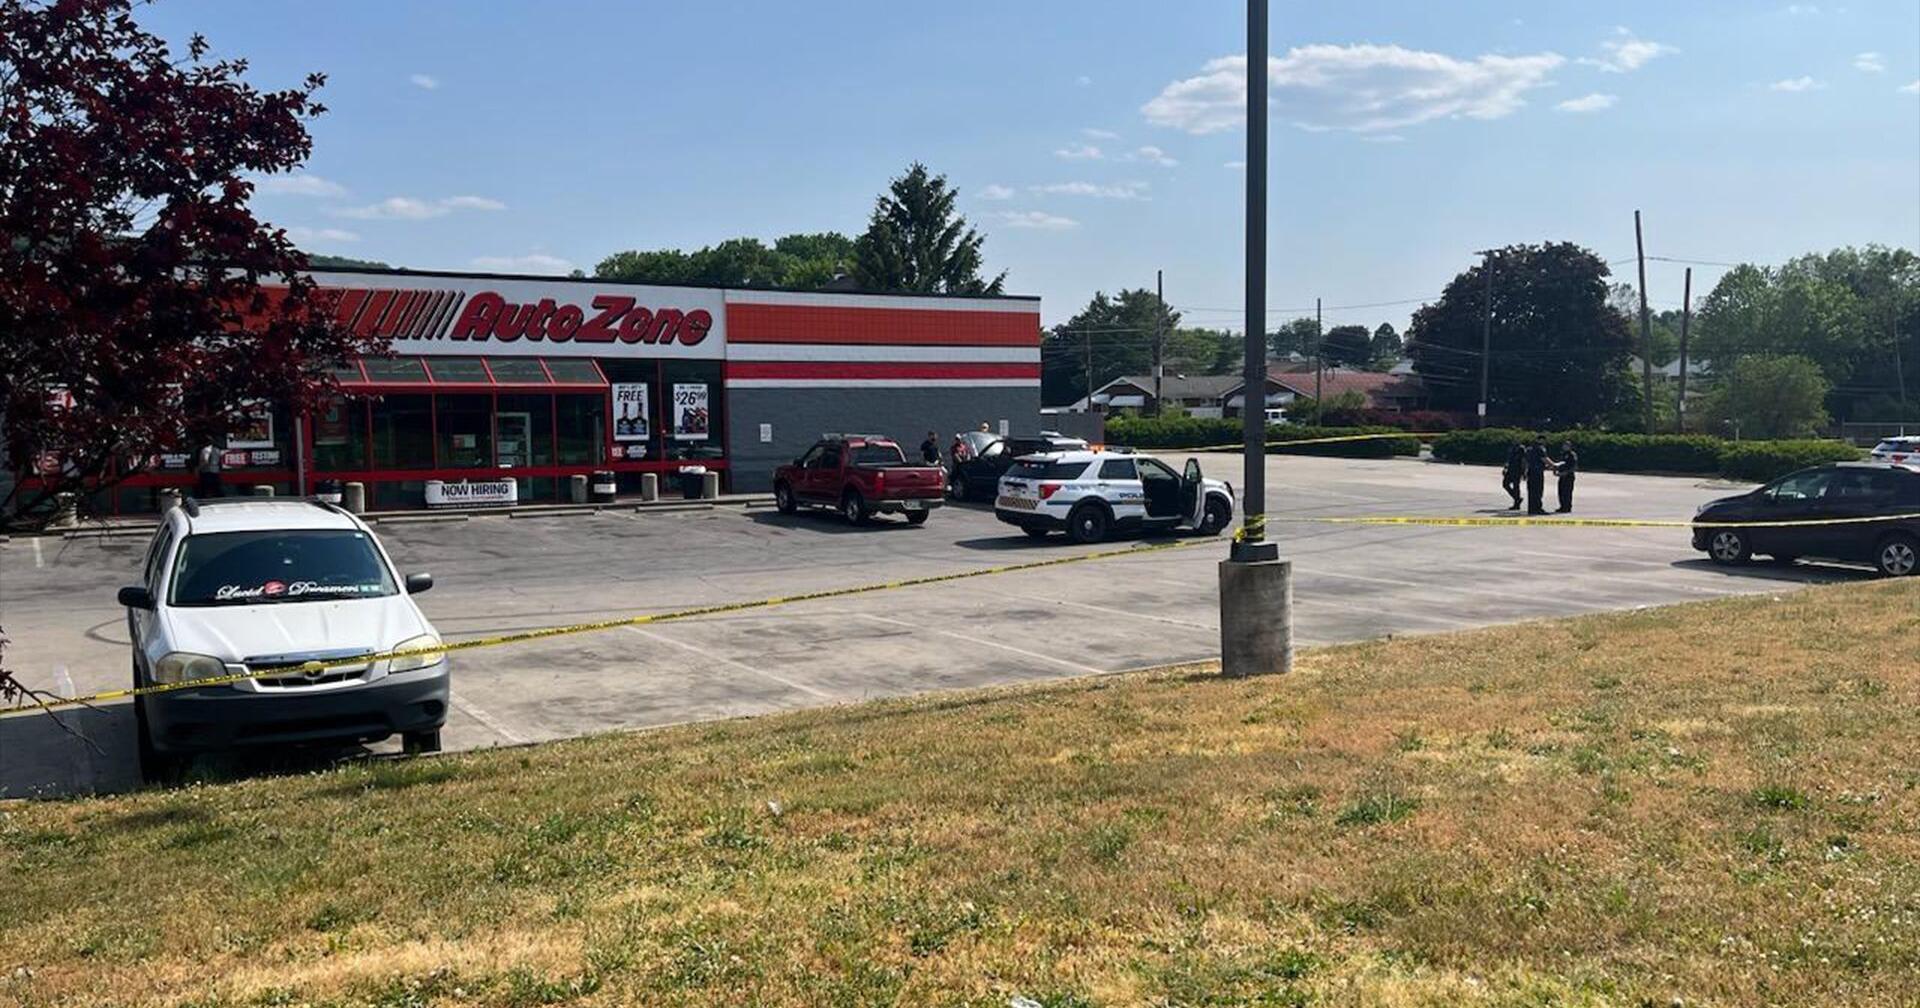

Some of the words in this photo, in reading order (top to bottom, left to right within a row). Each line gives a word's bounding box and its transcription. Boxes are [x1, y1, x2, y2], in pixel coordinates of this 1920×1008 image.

[451, 291, 712, 346] AutoZone
[617, 390, 643, 402] FREE
[224, 453, 247, 465] FREE
[441, 485, 469, 497] NOW
[471, 484, 509, 495] HIRING
[215, 584, 265, 600] Lucid
[287, 580, 360, 596] Dreamers
